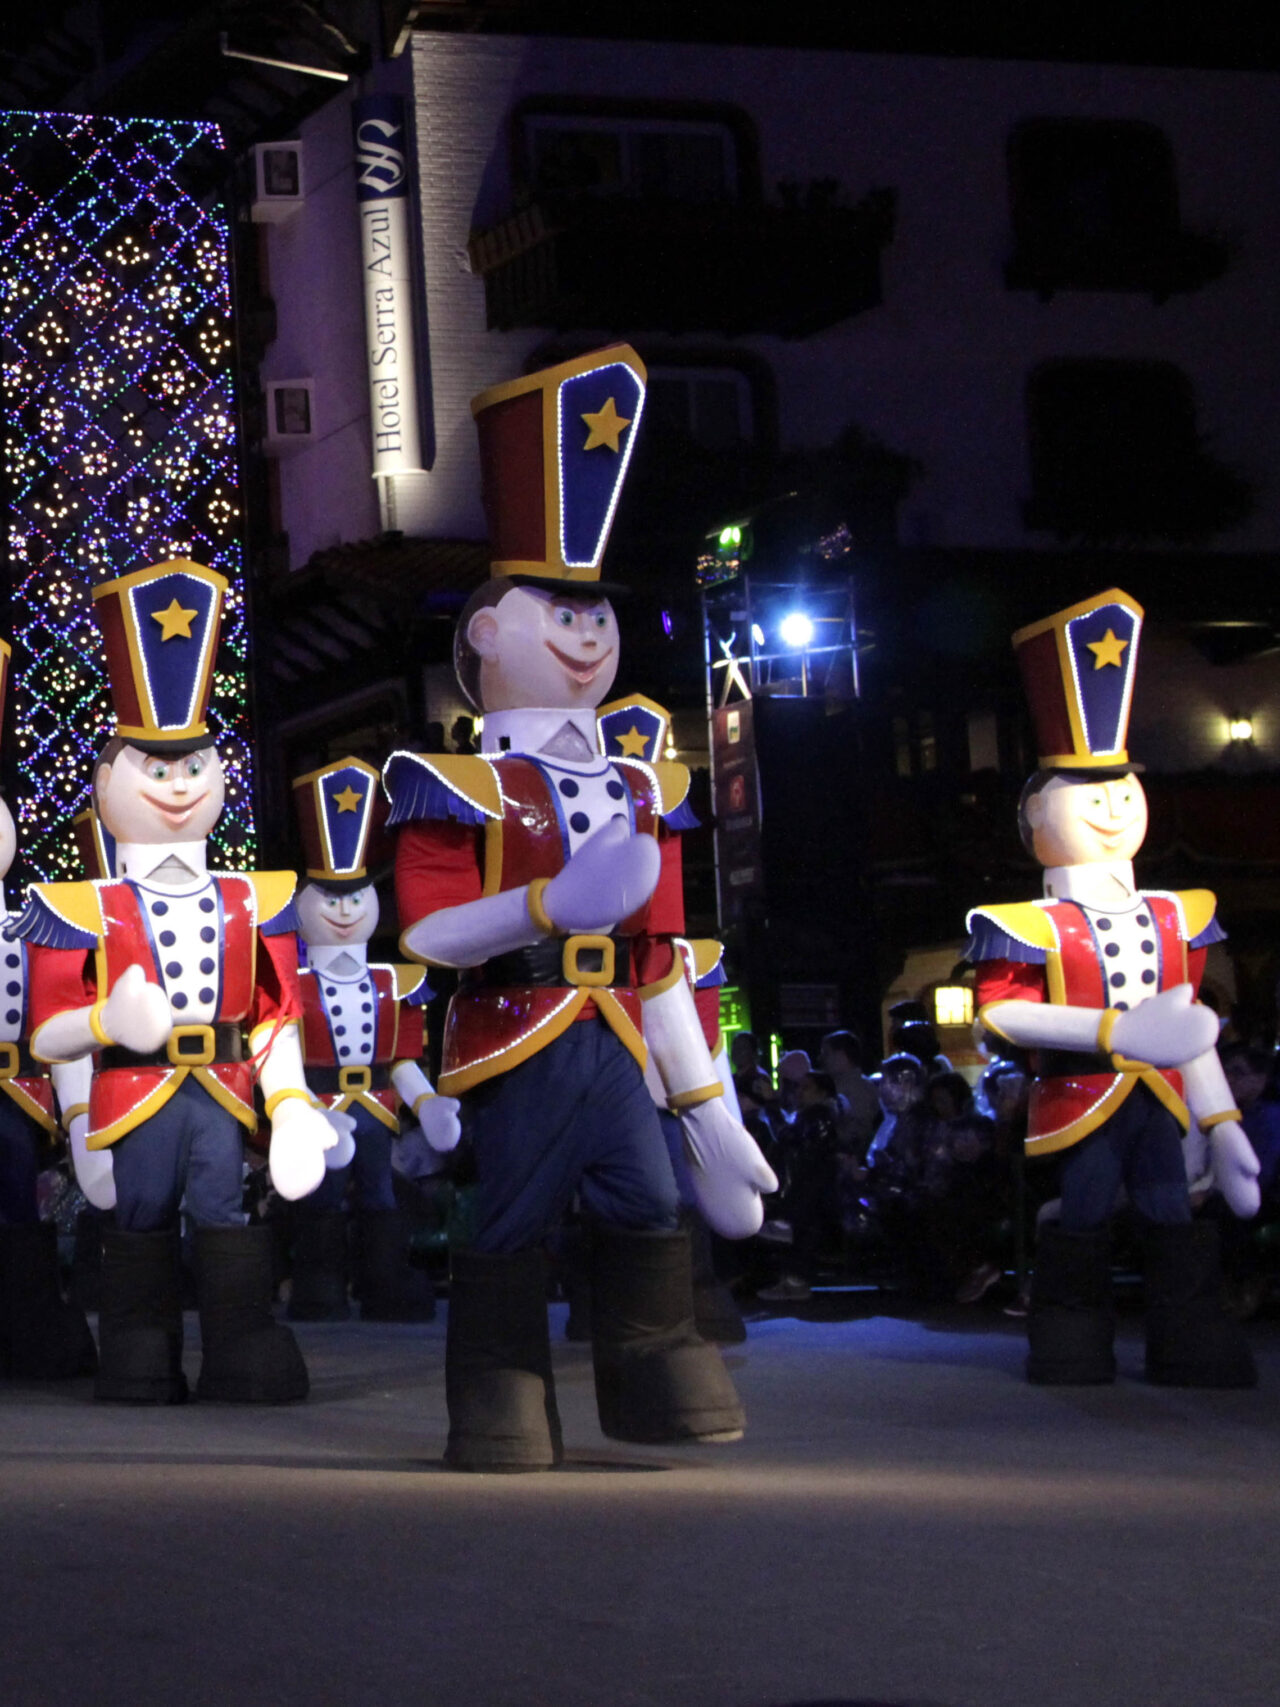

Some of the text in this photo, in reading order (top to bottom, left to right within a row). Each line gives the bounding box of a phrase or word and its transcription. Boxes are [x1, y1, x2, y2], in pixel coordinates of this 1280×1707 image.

[363, 207, 402, 454] Hotel Serra Azul
